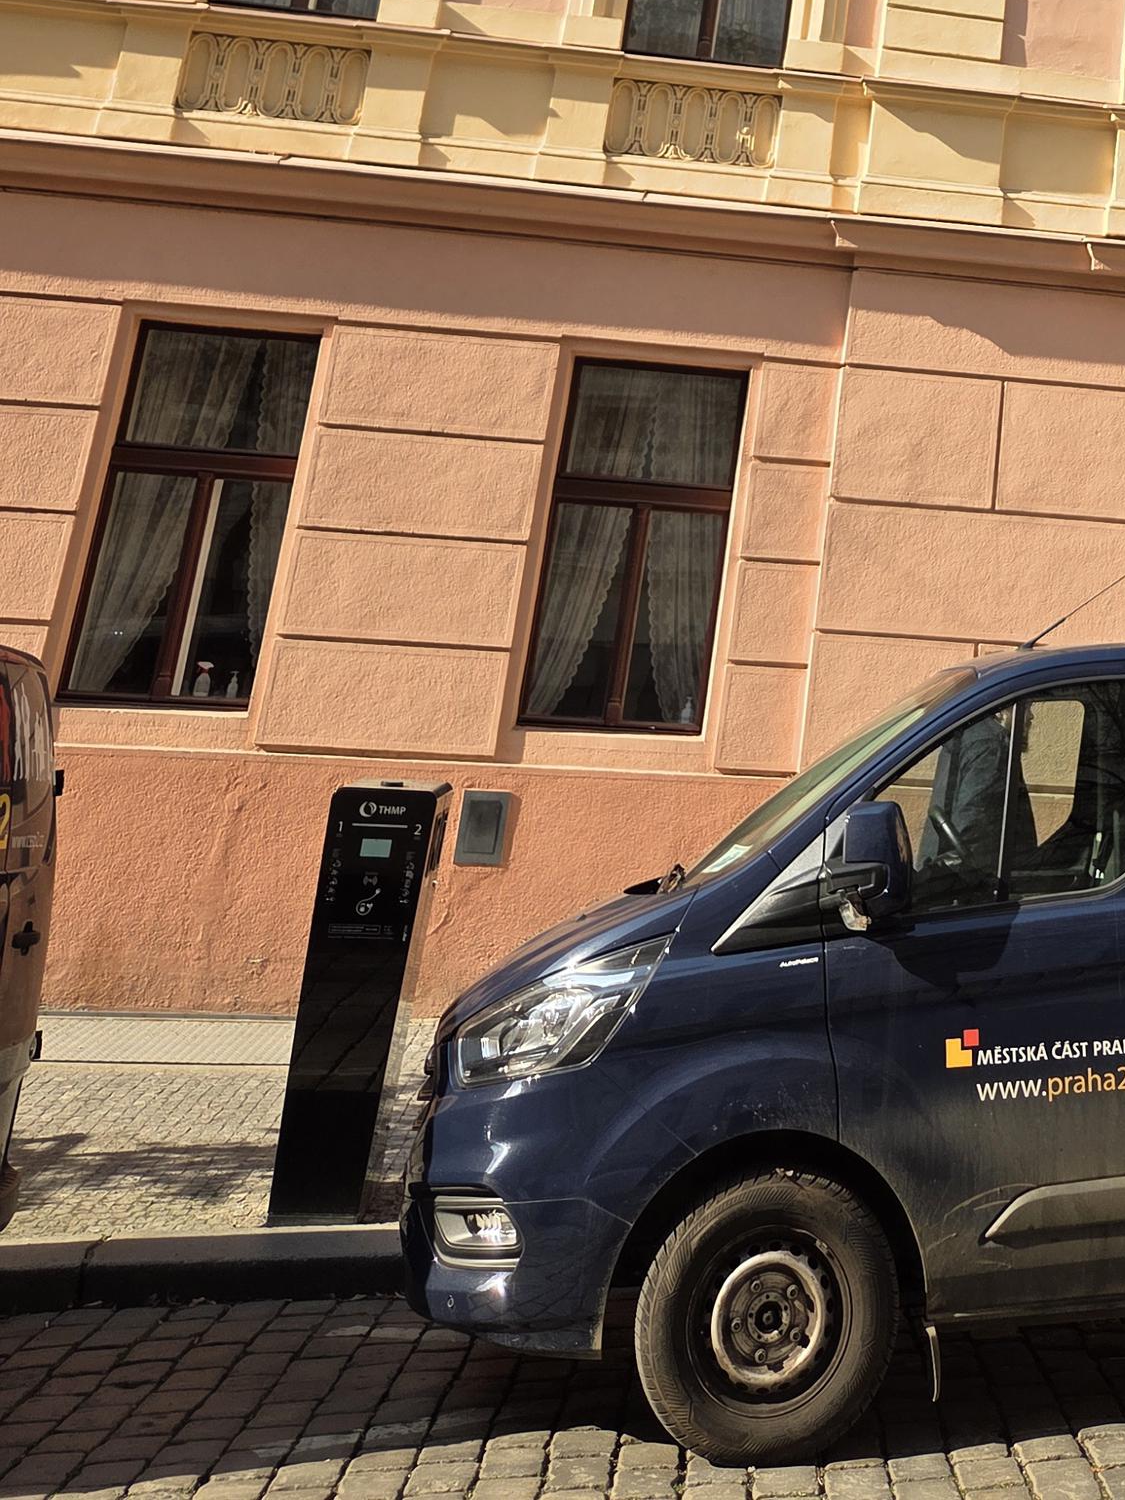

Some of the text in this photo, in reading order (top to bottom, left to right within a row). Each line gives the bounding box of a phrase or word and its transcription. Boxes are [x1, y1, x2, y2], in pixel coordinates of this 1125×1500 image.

[378, 805, 407, 816] THMP
[0, 794, 10, 849] 2
[338, 820, 423, 836] 1 2
[976, 1041, 1049, 1066] MĚSTSKÁ
[1051, 1040, 1089, 1060] ČÁST
